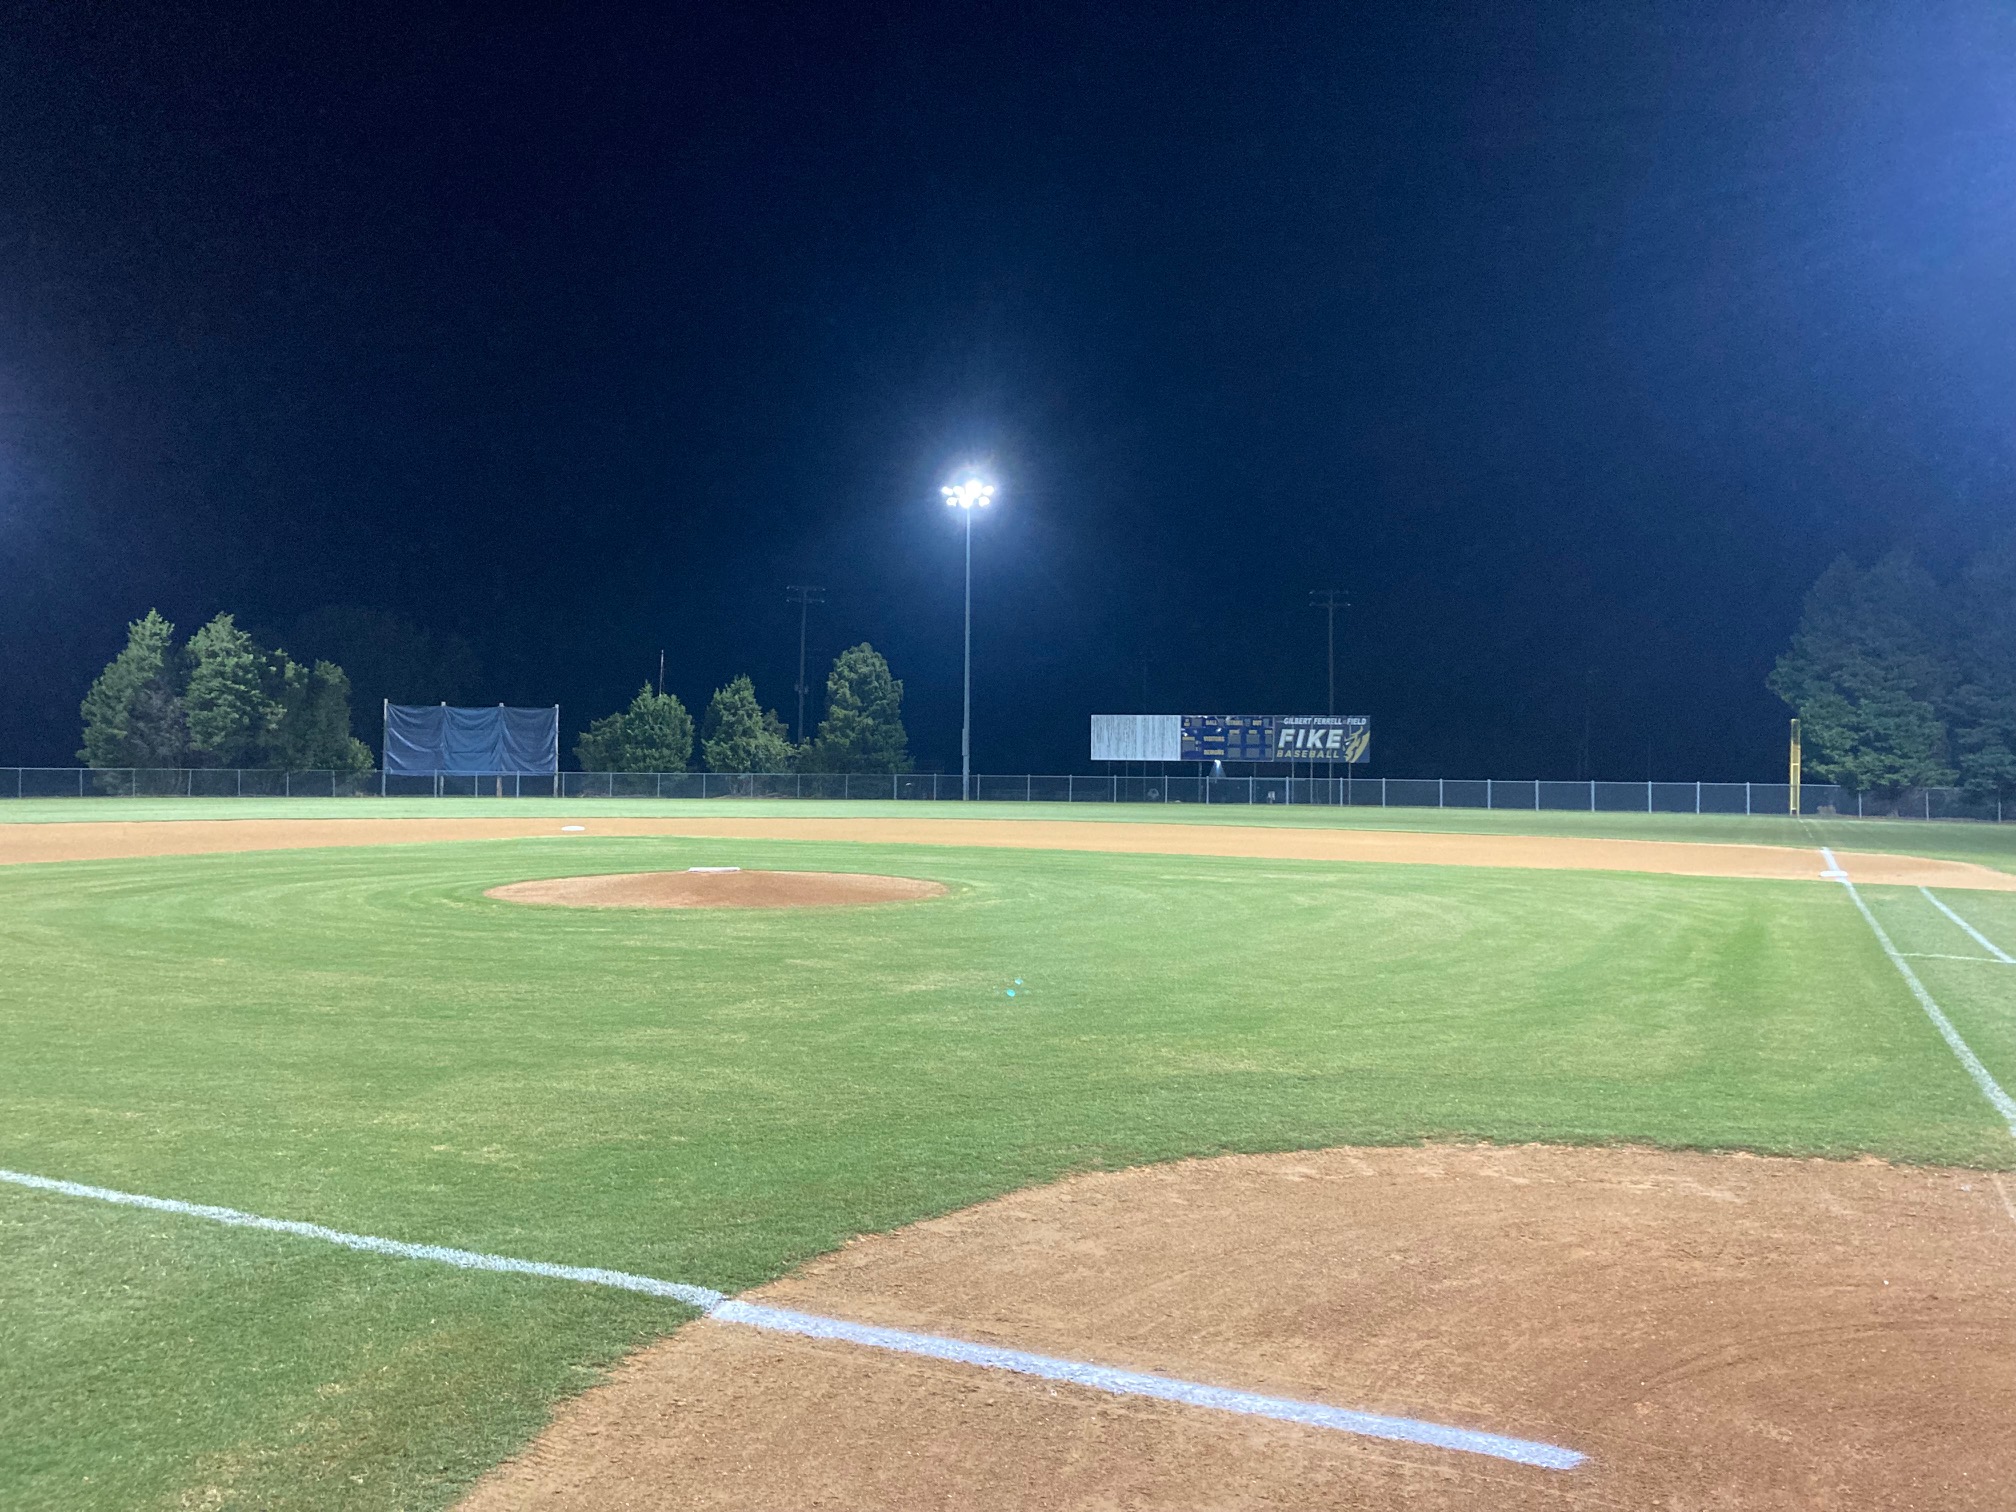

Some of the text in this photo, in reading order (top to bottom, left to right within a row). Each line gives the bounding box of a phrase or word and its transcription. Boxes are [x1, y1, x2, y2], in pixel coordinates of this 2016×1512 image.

[1283, 717, 1367, 725] GILBERT FERRELL FIELD
[1277, 728, 1344, 749] FIKE
[1276, 749, 1340, 758] BASEBALL
